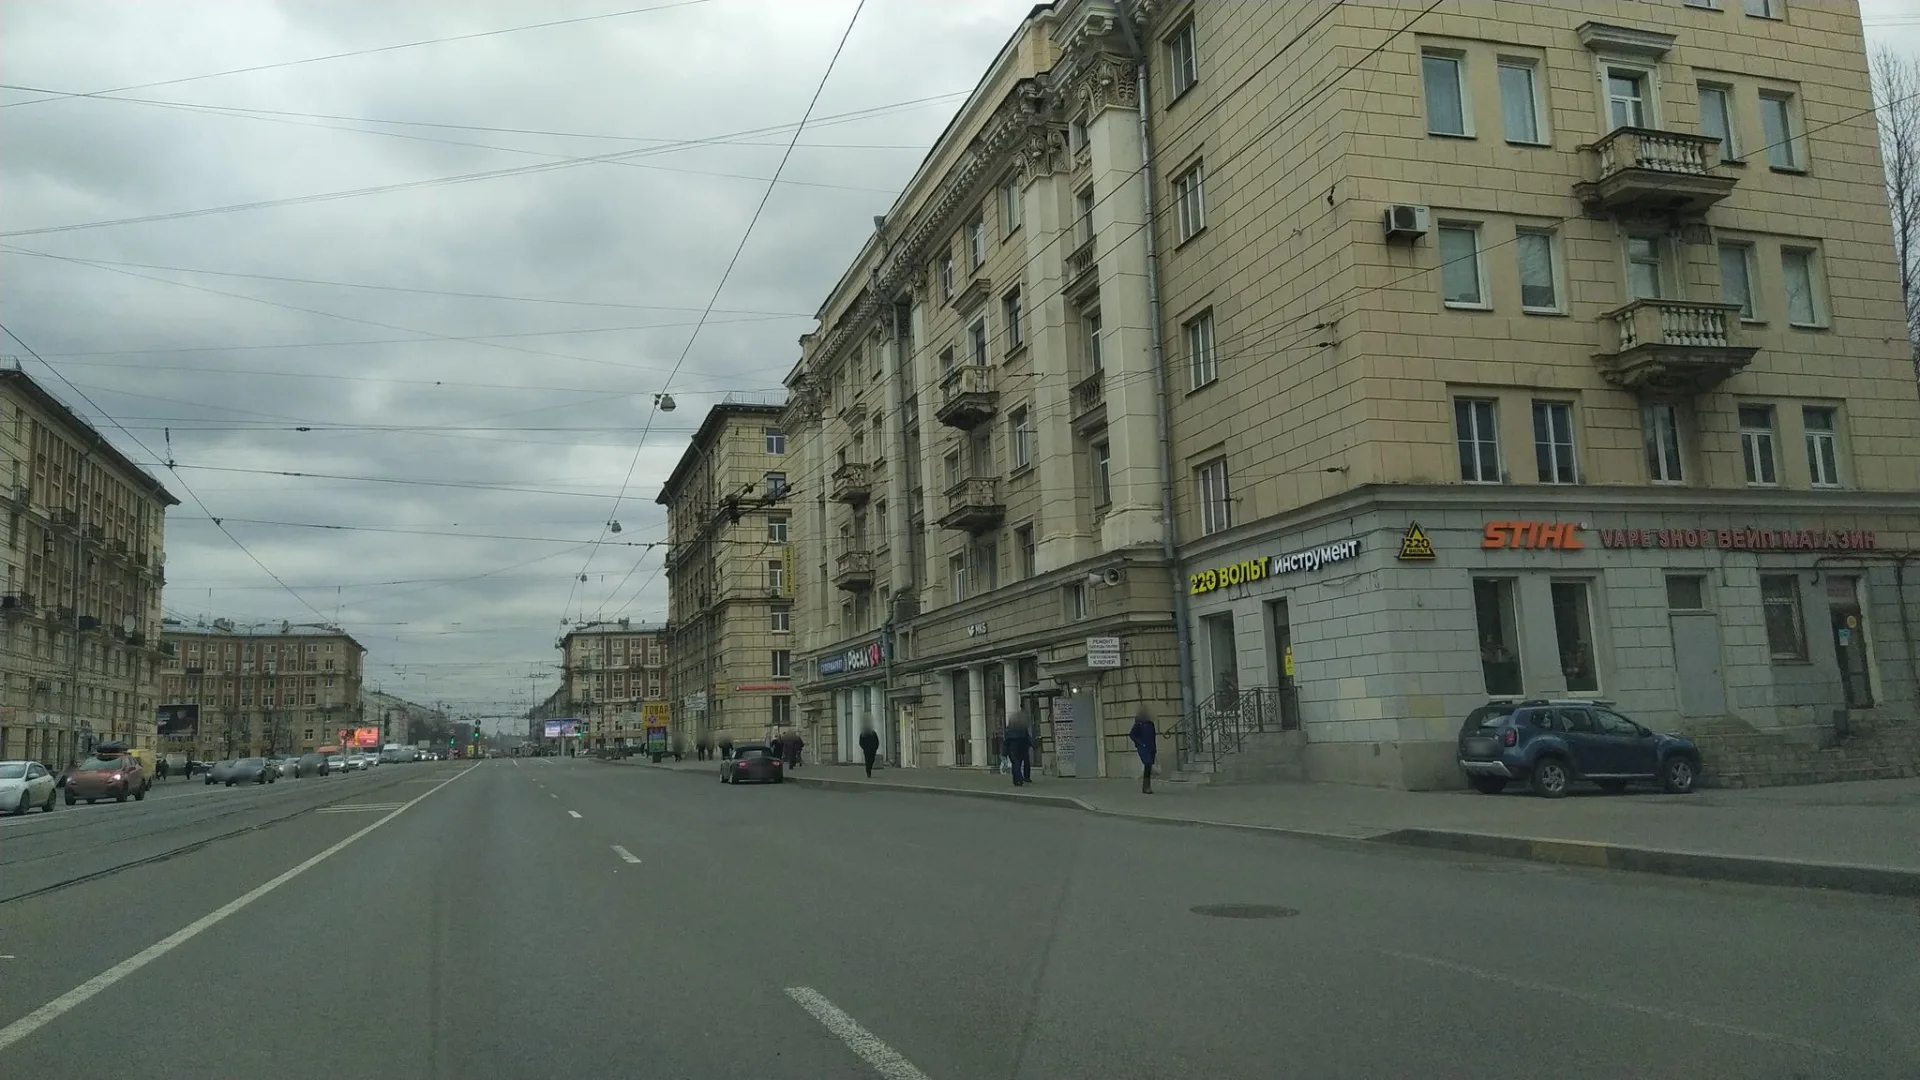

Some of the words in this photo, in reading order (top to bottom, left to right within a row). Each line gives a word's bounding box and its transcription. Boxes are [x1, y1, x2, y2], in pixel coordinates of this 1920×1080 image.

[1405, 538, 1430, 548] 220
[1482, 521, 1585, 550] STIHL
[1600, 528, 1651, 548] VAPE
[1659, 529, 1710, 549] SHOP
[1783, 529, 1876, 549] МАГАЗИН
[1189, 569, 1217, 595] 220
[1218, 556, 1269, 588] ВОЛЬТ
[1274, 540, 1359, 575] инструмент
